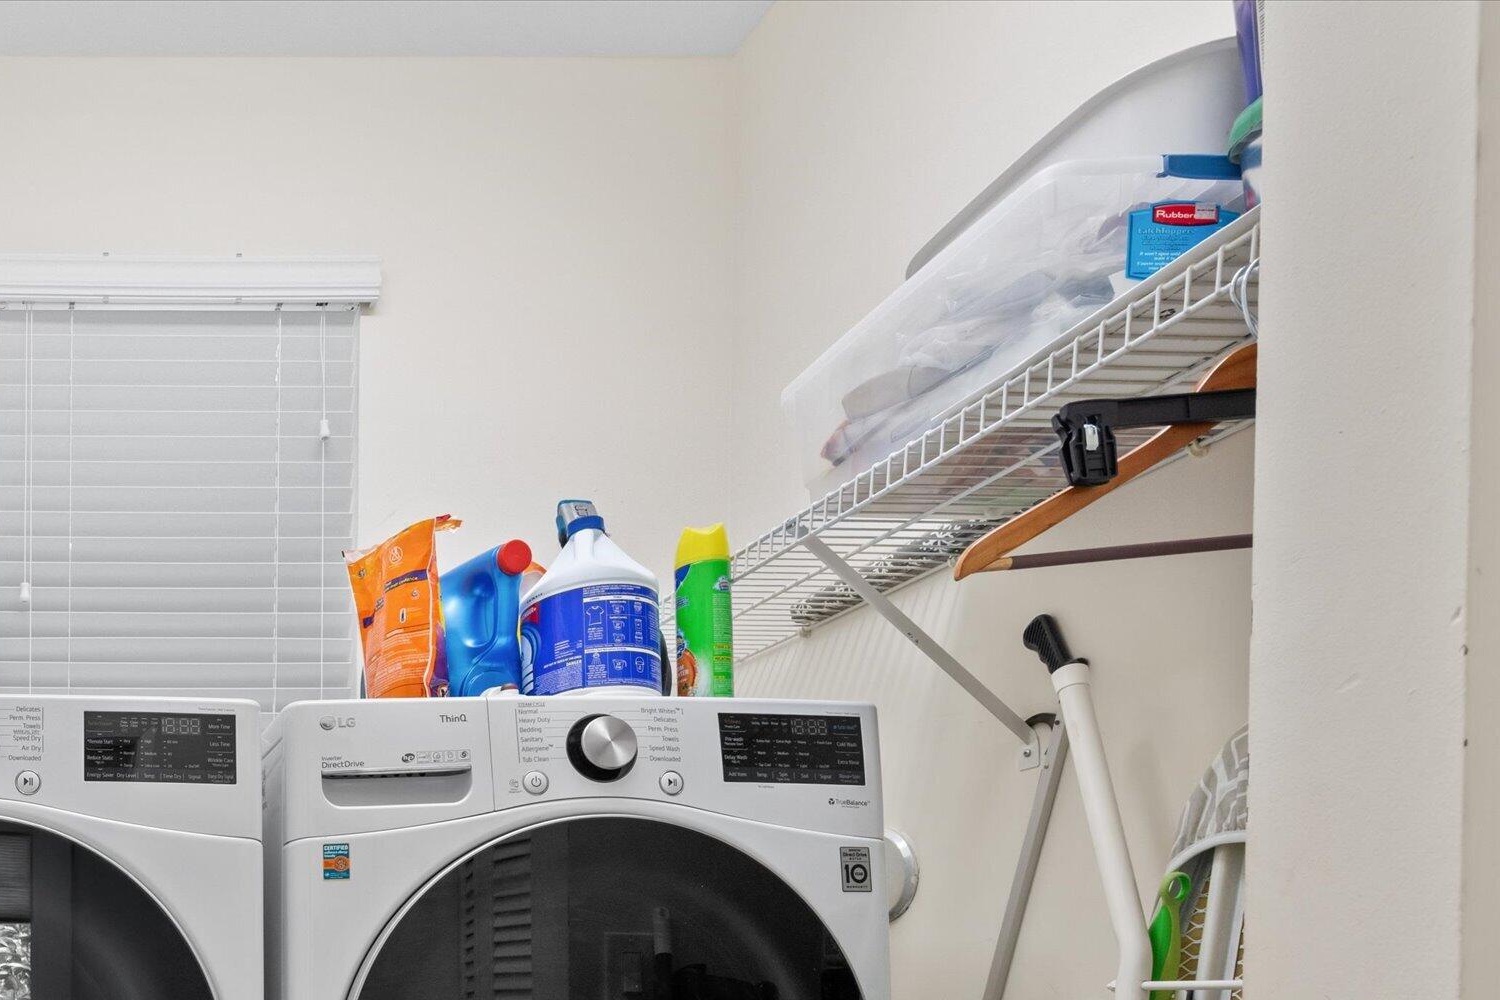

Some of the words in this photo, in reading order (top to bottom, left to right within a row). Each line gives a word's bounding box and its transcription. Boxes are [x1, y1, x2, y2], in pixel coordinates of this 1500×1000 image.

[1156, 209, 1196, 219] Rubber
[338, 717, 356, 728] LG
[440, 714, 467, 723] ThinQ
[844, 864, 868, 883] 10
